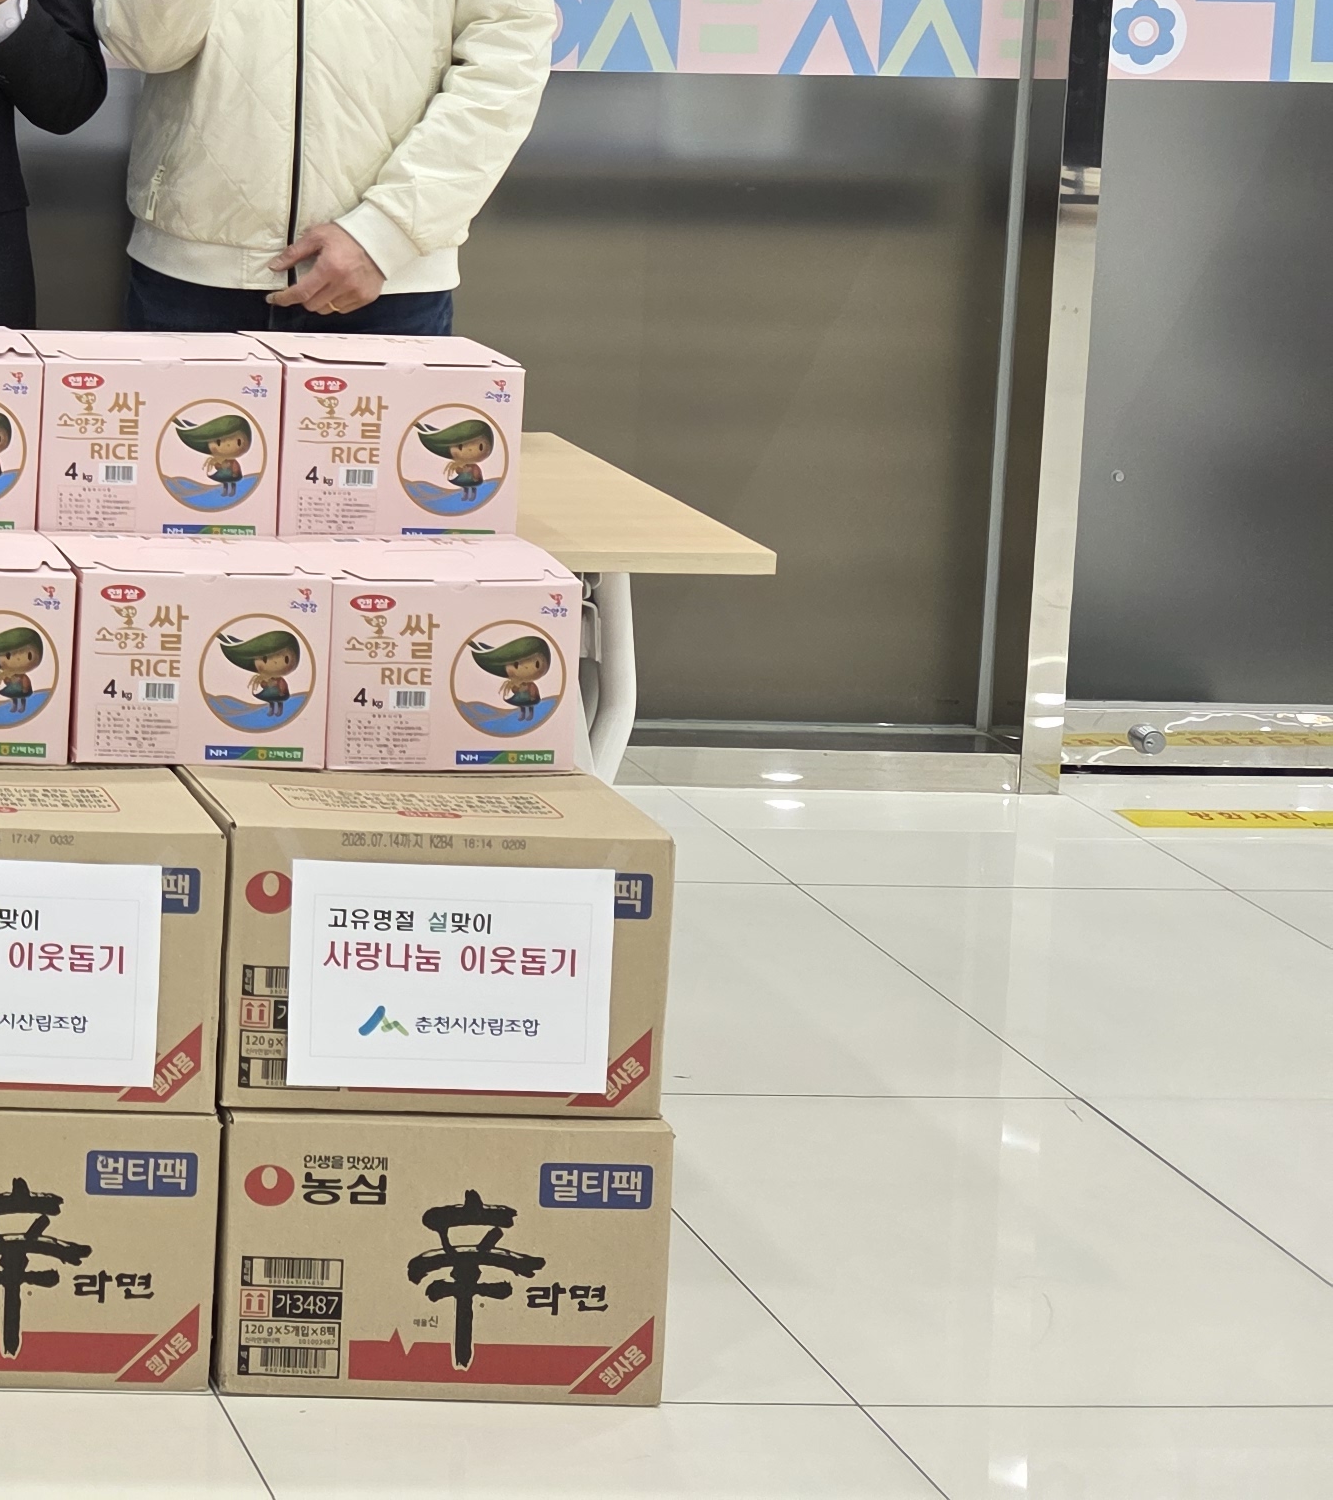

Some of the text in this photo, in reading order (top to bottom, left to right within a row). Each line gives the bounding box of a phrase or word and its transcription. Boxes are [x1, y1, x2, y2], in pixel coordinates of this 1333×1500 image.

[349, 395, 389, 442] 쌀
[331, 445, 381, 465] RICE
[130, 659, 180, 677] RICE
[327, 907, 492, 935] 고유명절 설맞이
[8, 941, 125, 974] 이웃돕기
[323, 940, 577, 977] 사랑나눔 이웃돕기
[415, 1016, 540, 1037] 춘천시산림조합
[96, 1155, 188, 1190] 멀티팩
[301, 1173, 387, 1205] 농심
[550, 1169, 643, 1202] 멀티팩
[407, 1189, 546, 1369] 辛
[274, 1294, 339, 1315] 가3487
[525, 1282, 609, 1316] 라면
